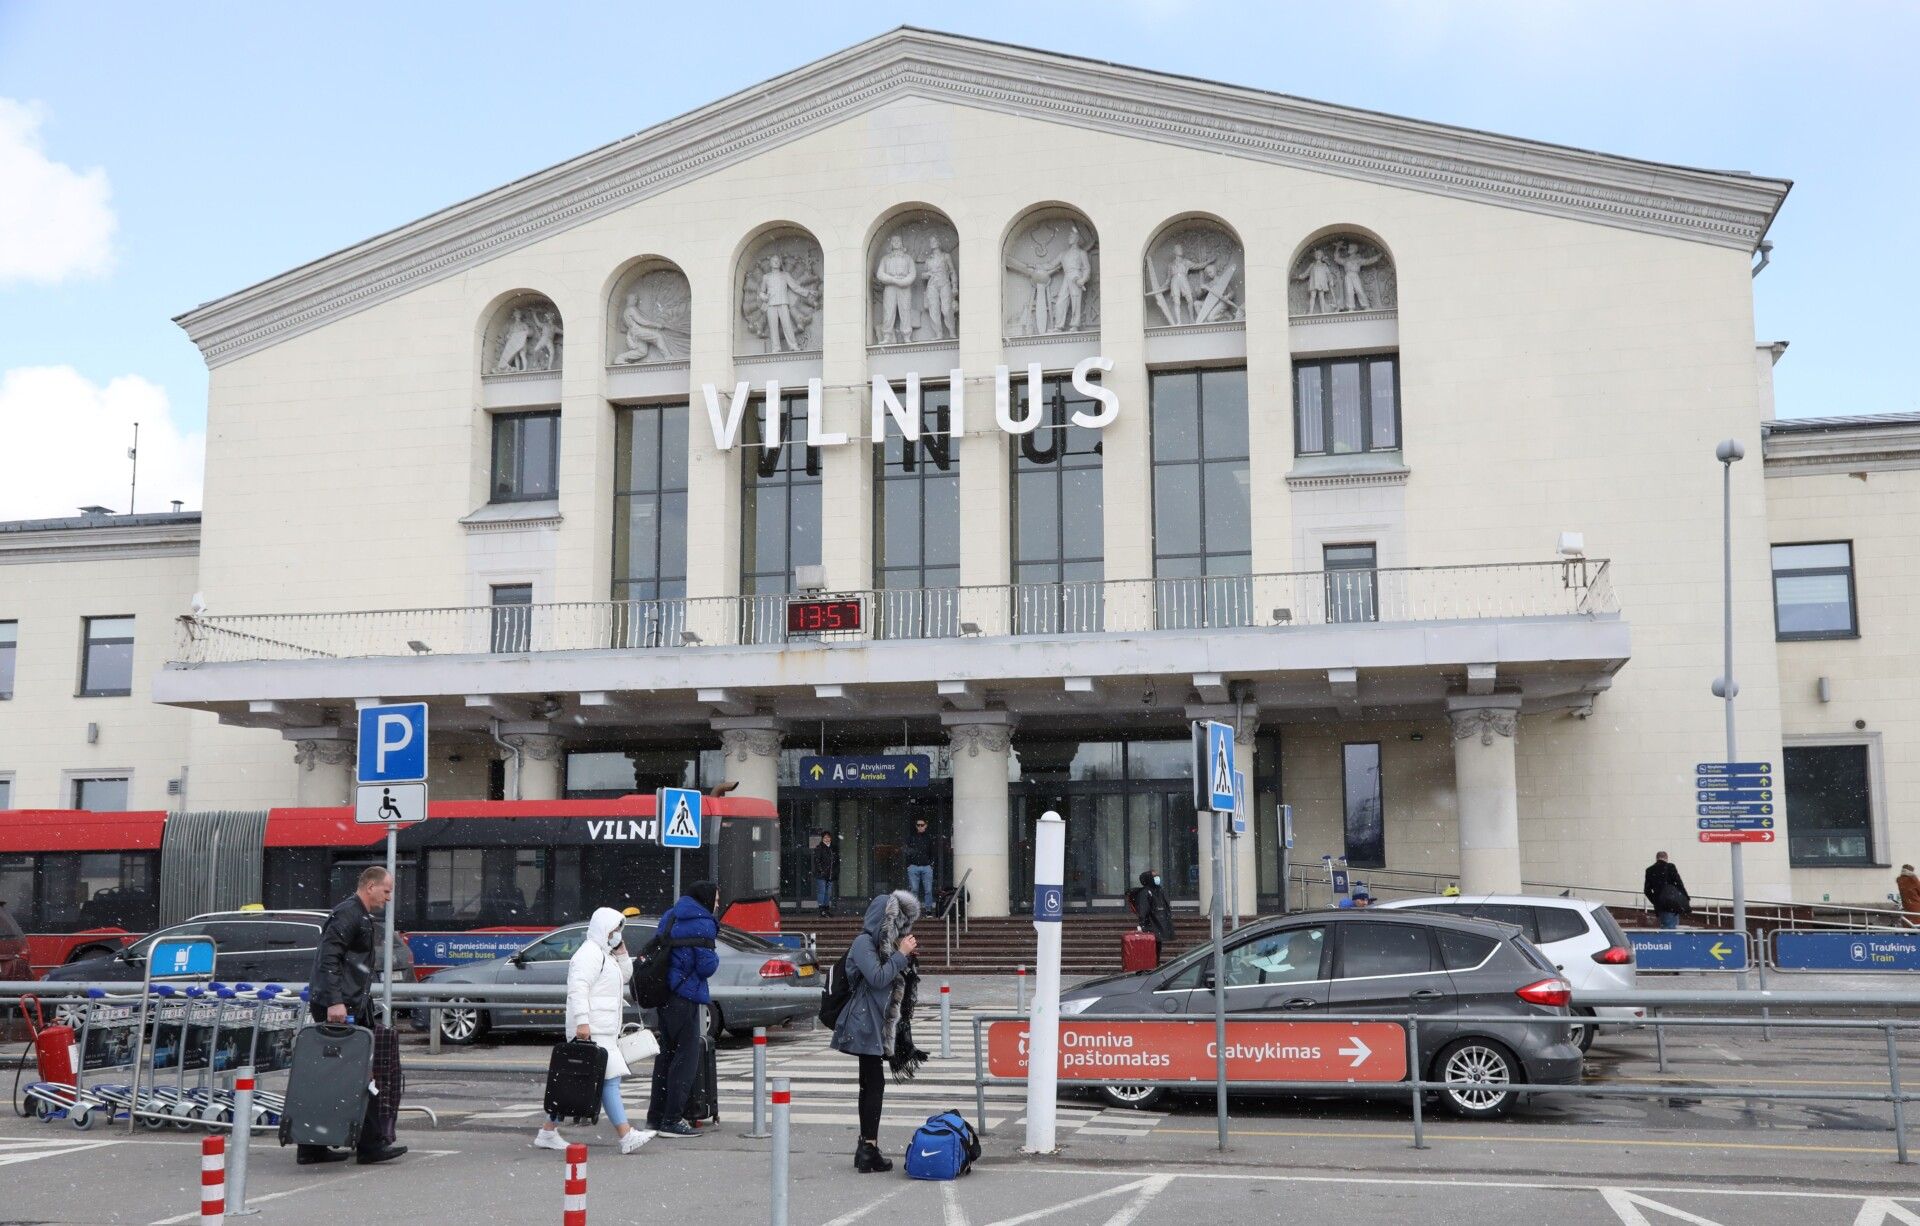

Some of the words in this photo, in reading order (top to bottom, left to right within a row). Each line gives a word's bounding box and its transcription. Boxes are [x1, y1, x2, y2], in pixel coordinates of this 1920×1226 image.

[702, 356, 1120, 450] VILNIUS
[800, 604, 858, 628] 13:57
[376, 713, 413, 774] P
[832, 763, 845, 780] A
[860, 763, 895, 771] Atvykimas
[860, 772, 886, 780] Arrivals
[448, 942, 497, 951] Tarpmiestiniai
[1870, 942, 1917, 954] Traukinys
[448, 951, 473, 959] Shuttle
[475, 951, 496, 959] buses
[1871, 953, 1895, 962] Train
[1063, 1030, 1133, 1048] Omniva
[1063, 1049, 1170, 1069] paštomatas
